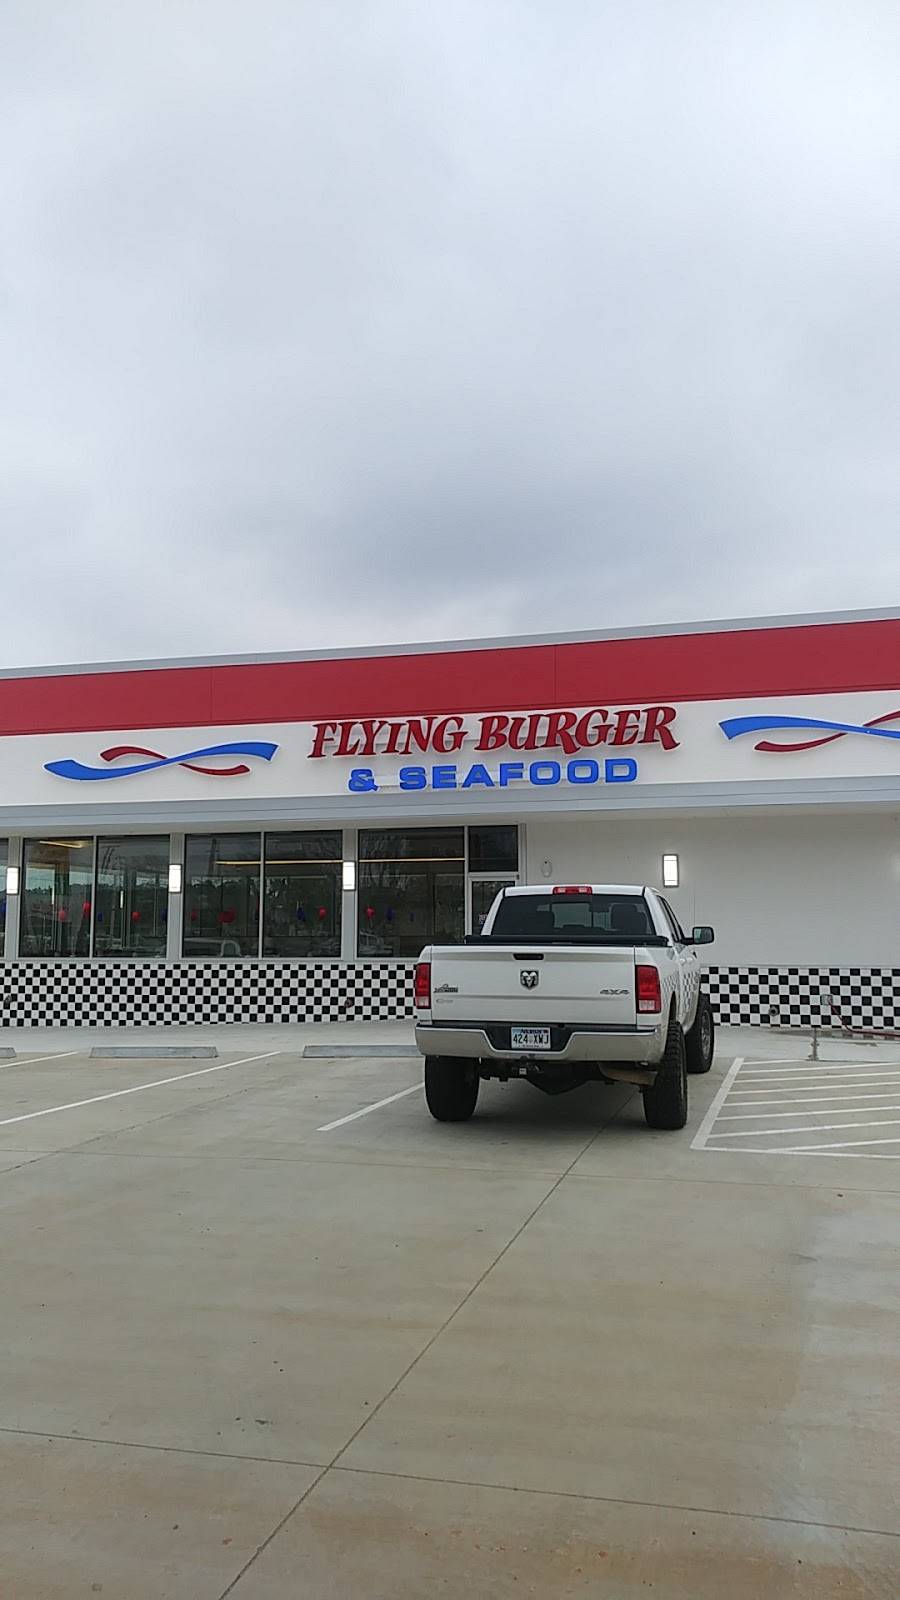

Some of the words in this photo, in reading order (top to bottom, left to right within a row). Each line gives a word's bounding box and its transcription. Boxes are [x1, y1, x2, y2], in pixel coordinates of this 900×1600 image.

[307, 716, 468, 758] FLYING
[474, 706, 680, 755] BURGER
[348, 768, 379, 792] &
[399, 758, 638, 791] SEAFOOD
[512, 1033, 529, 1044] 424
